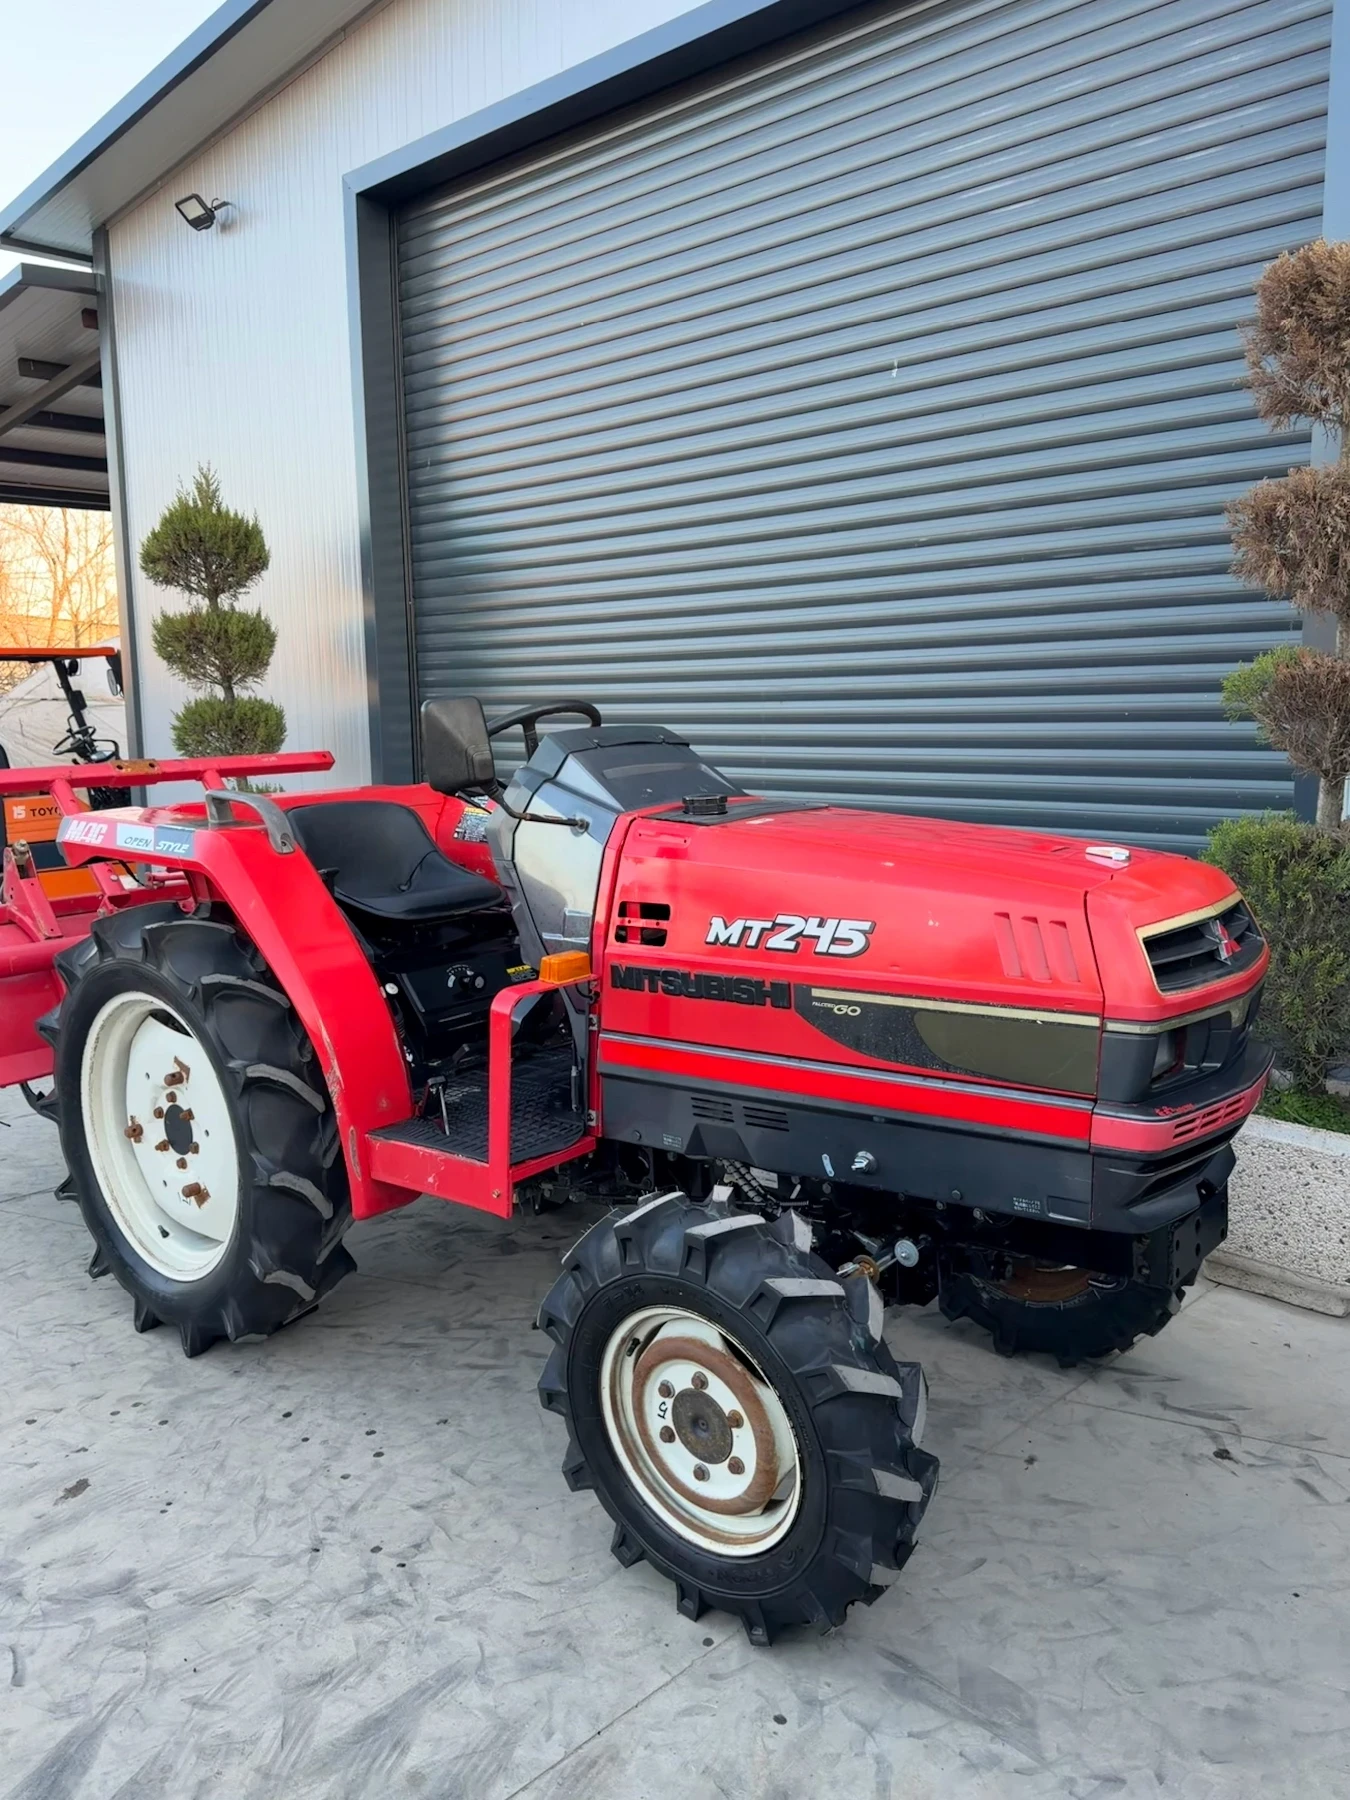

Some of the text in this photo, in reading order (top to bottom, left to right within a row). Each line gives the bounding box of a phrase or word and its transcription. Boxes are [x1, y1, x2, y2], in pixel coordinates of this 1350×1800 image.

[65, 820, 190, 854] MAC OPEN STYLE
[705, 914, 876, 957] MT245
[610, 964, 791, 1009] MITSUBISHI
[833, 1004, 861, 1016] GO
